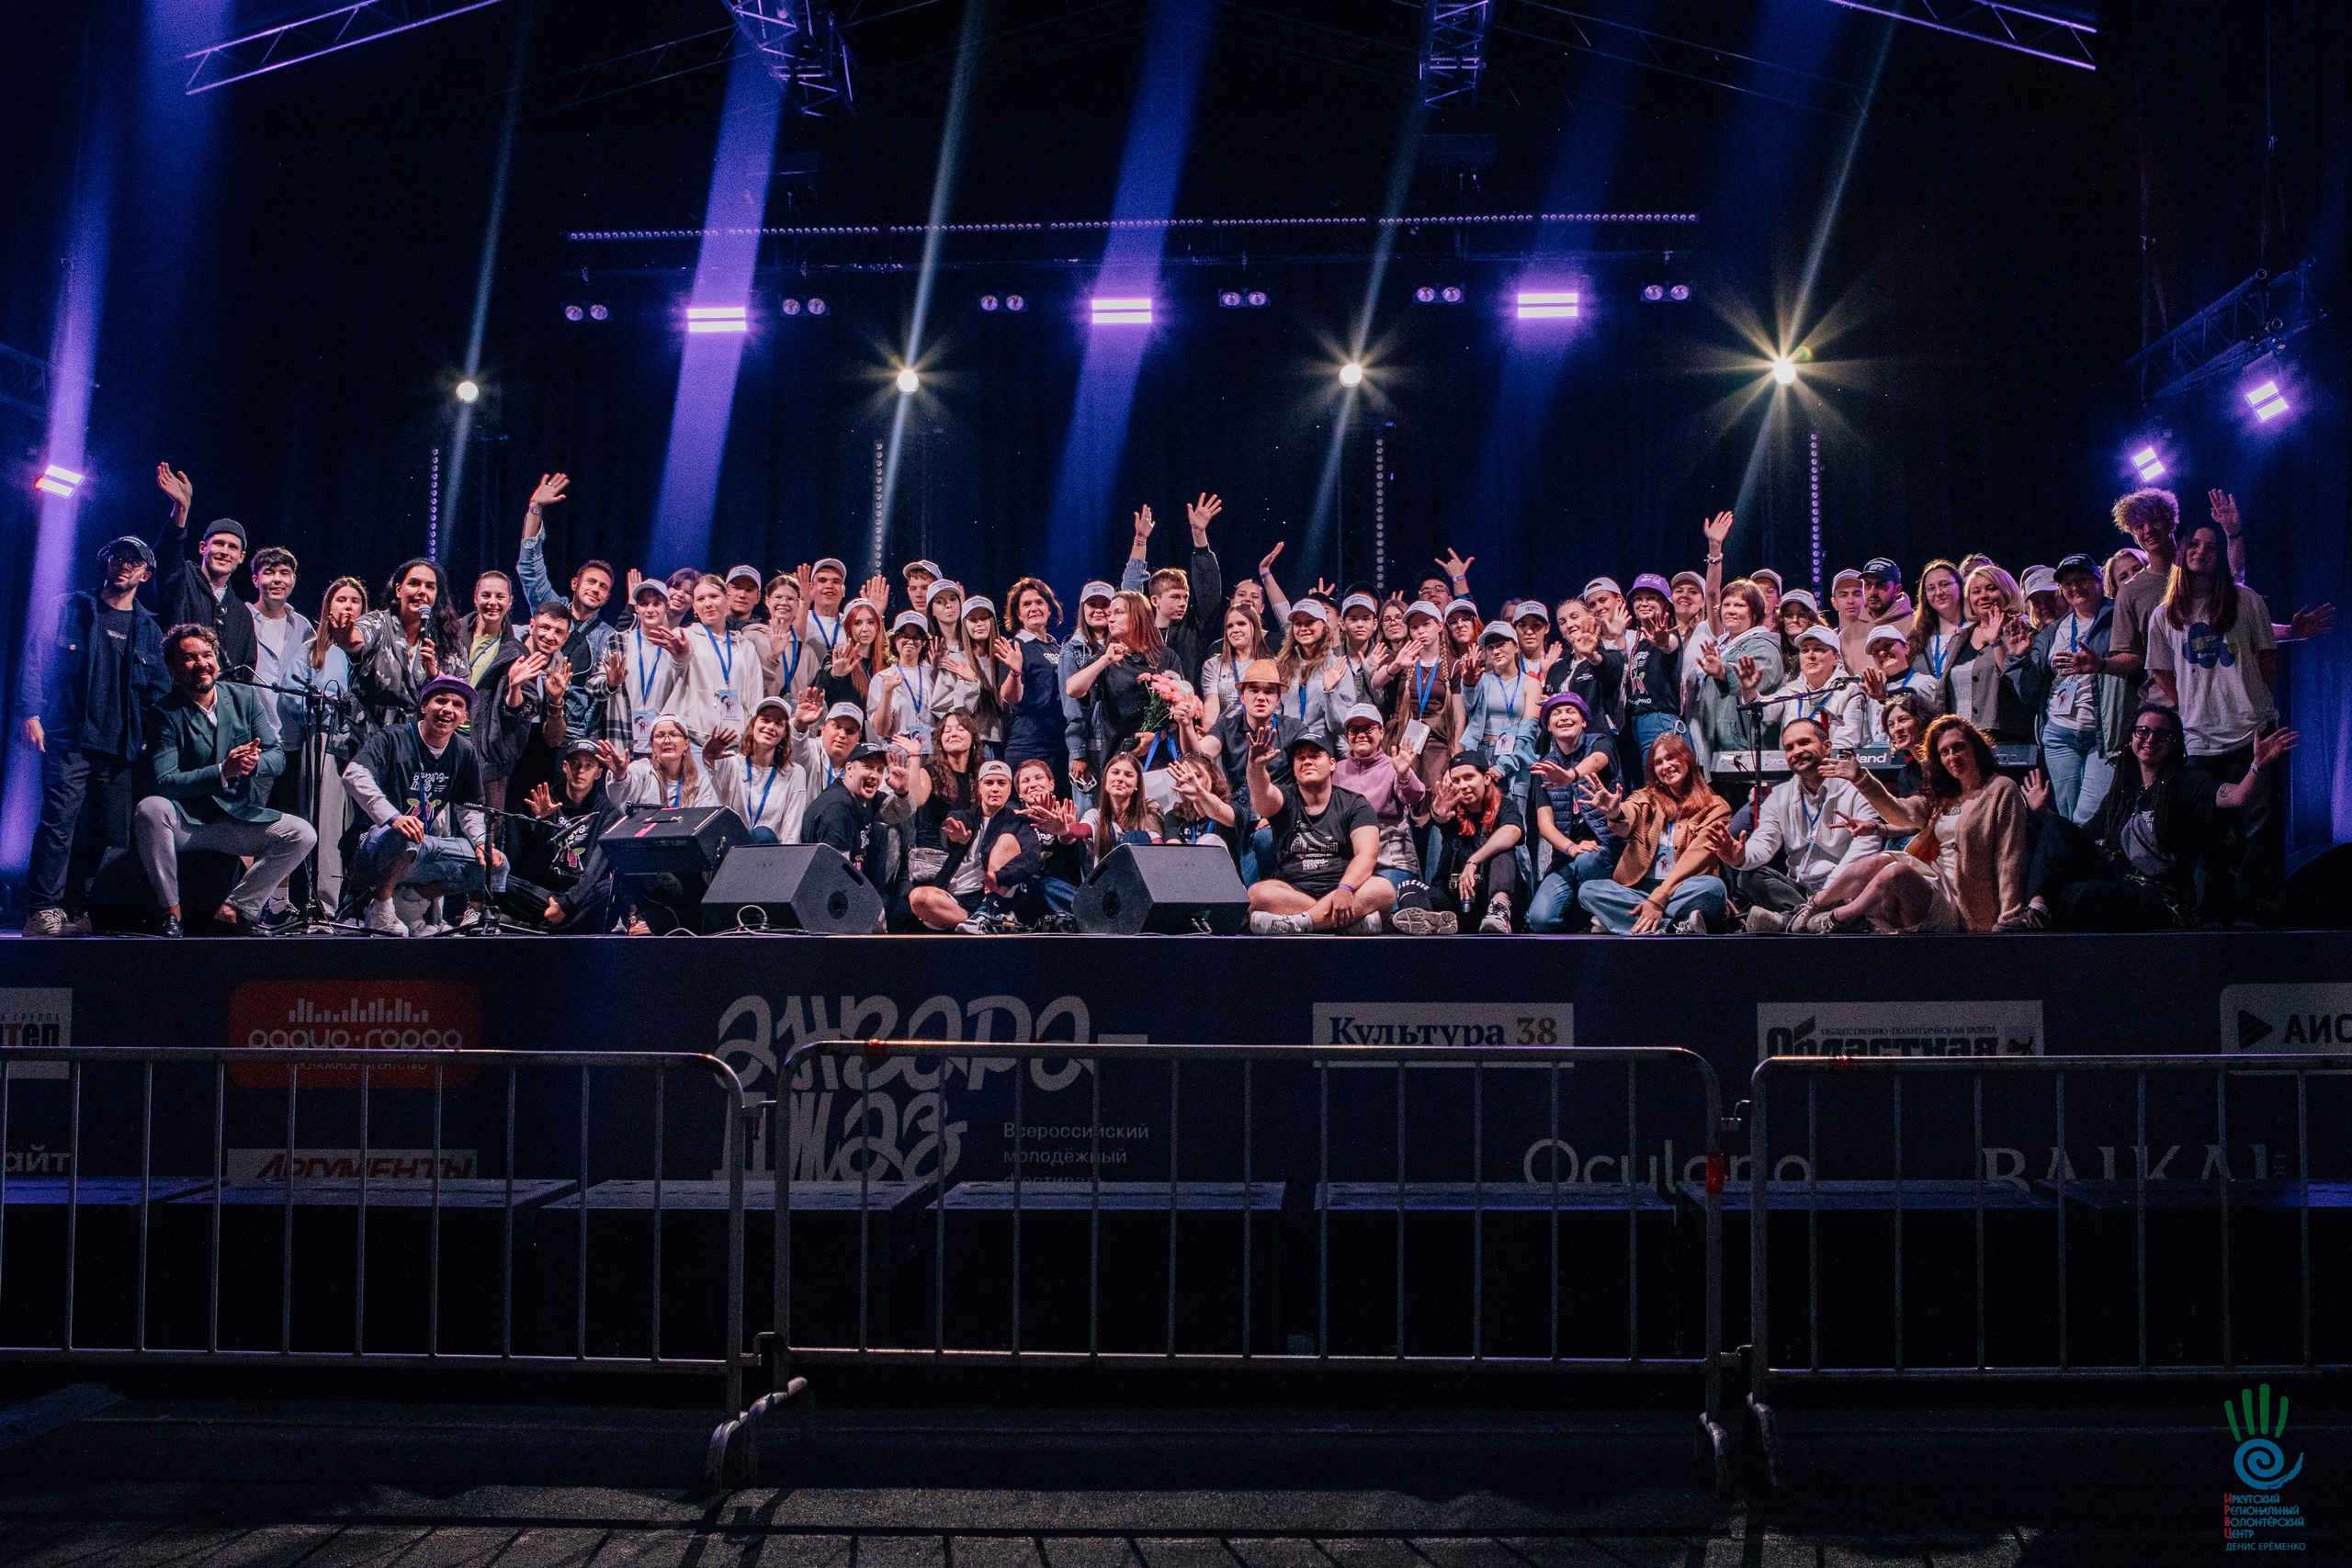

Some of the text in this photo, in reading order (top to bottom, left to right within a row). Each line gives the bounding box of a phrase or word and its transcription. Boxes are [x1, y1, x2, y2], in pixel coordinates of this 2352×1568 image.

[1837, 752, 1888, 763] Rland
[14, 1013, 60, 1021] ГРУППА
[1329, 1017, 1558, 1046] Культура 38
[2283, 1013, 2352, 1043] АИС
[1003, 1148, 1127, 1167] молодёжый
